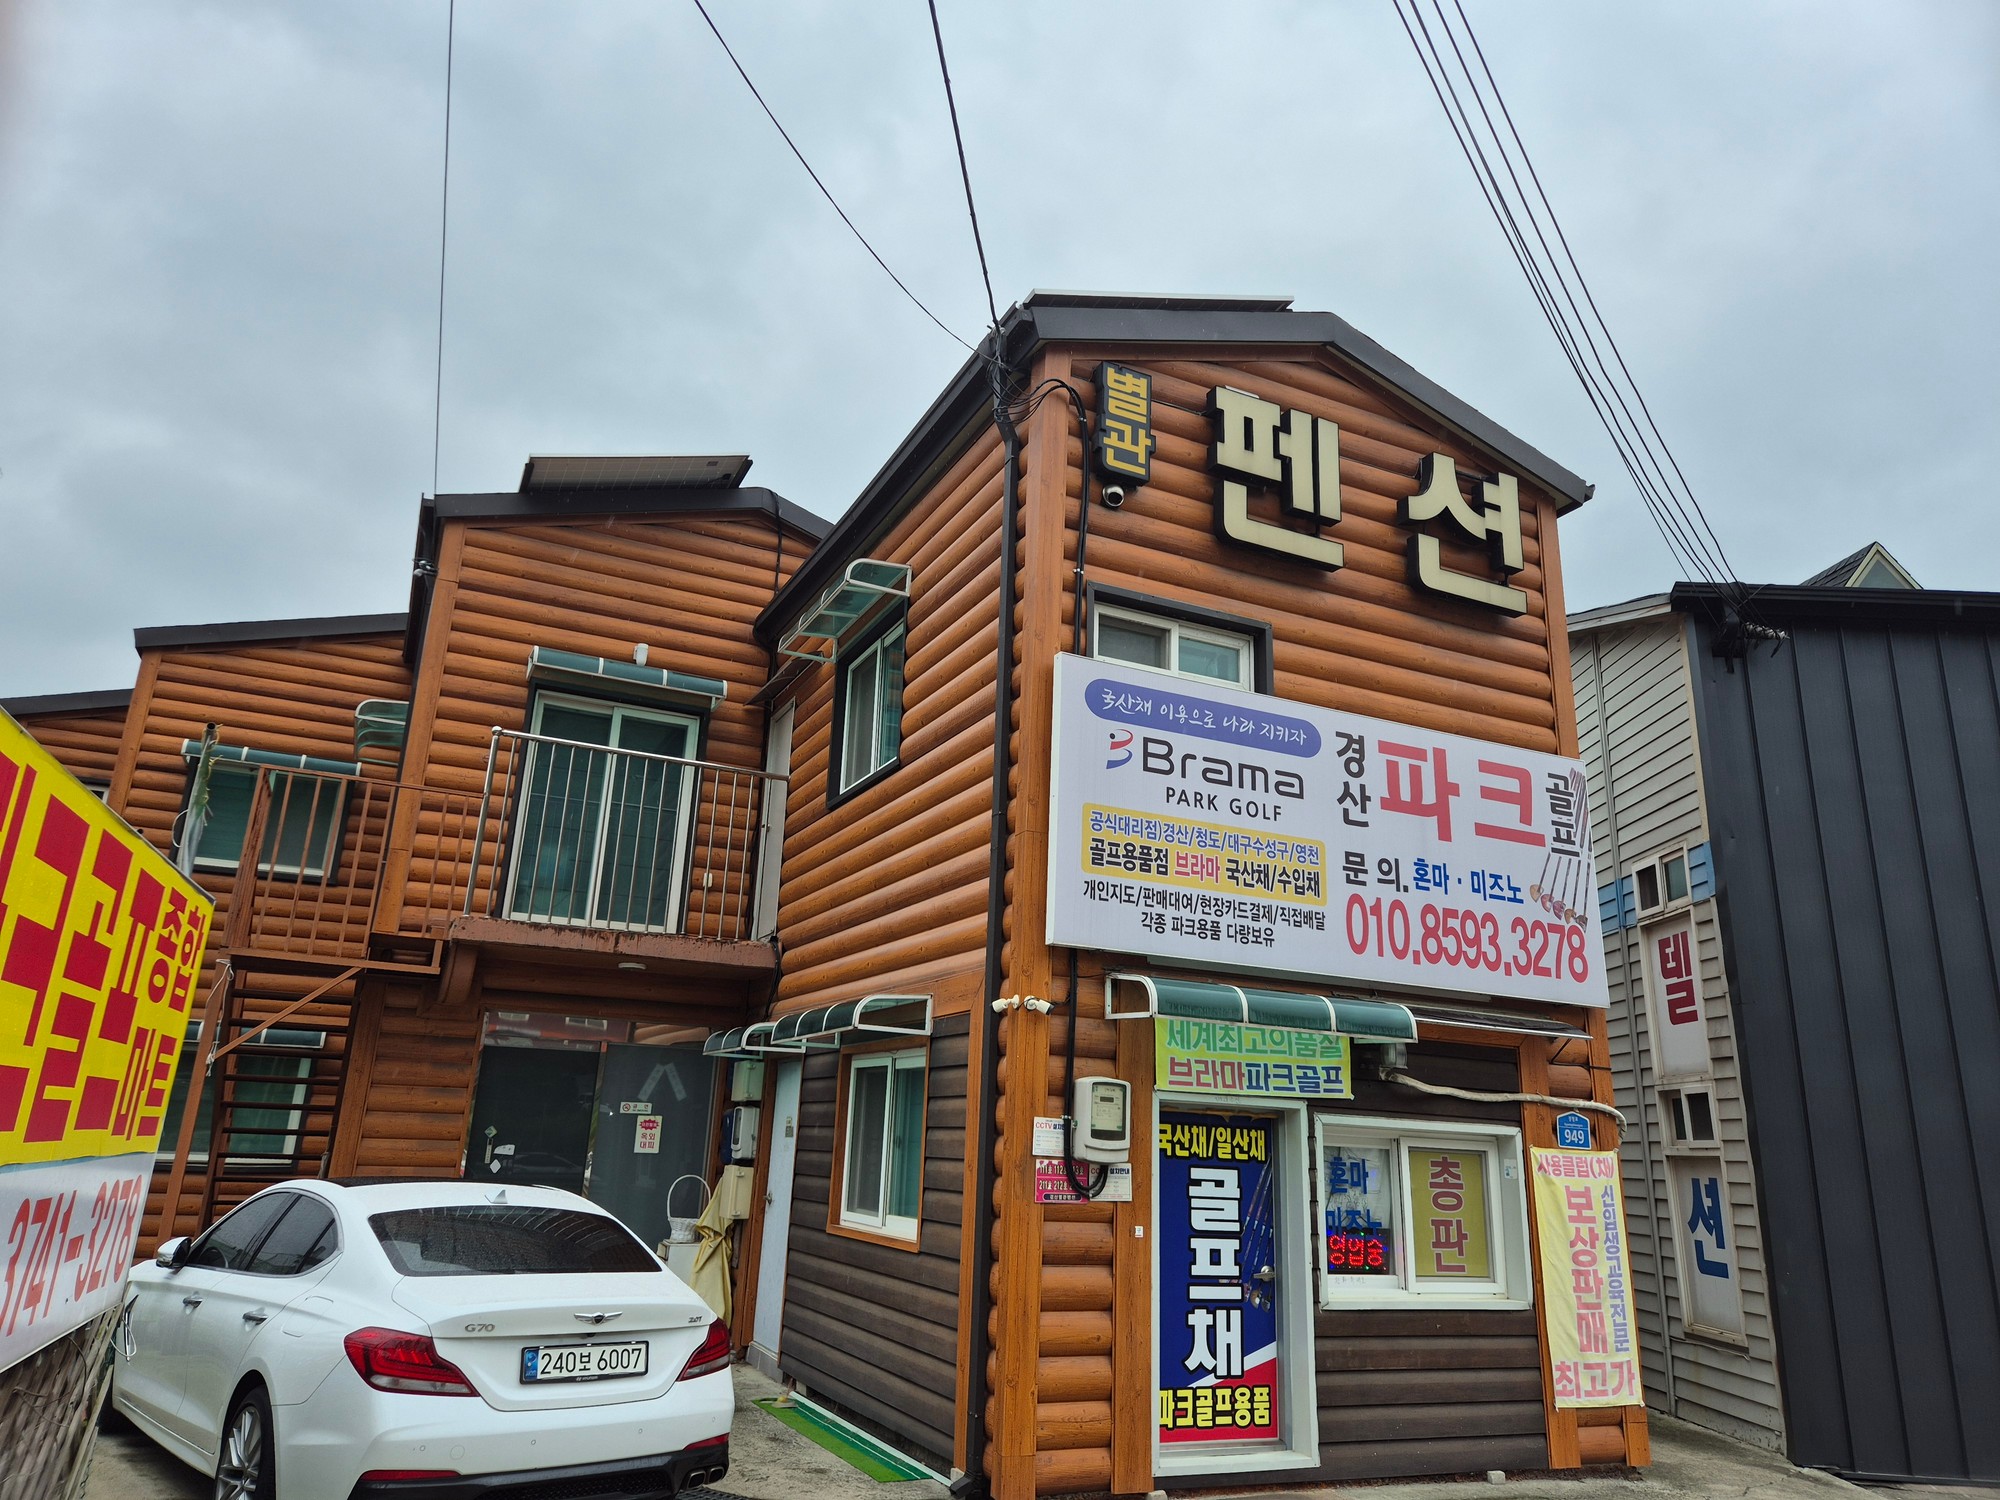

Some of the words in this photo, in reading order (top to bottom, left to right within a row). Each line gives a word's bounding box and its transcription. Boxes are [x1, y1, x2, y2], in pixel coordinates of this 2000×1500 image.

[1104, 367, 1151, 475] 별관
[1210, 386, 1527, 617] 펜션
[1101, 687, 1152, 716] 국산채
[1160, 703, 1217, 729] 이용으로
[1223, 716, 1255, 735] 나라
[1261, 723, 1307, 746] 지키자
[1142, 736, 1305, 800] Brama
[1336, 731, 1371, 827] 경산
[1377, 740, 1546, 848] 파크
[1545, 772, 1580, 858] 골프
[1166, 786, 1219, 812] PARK
[1229, 801, 1282, 822] GOLF
[1089, 836, 1169, 877] 골프용품점
[1174, 851, 1221, 885] 브라마
[1225, 858, 1320, 899] 국산채/수입채
[1412, 857, 1450, 895] 혼마
[1469, 869, 1524, 905] 미즈노
[148, 886, 204, 1012] 종합
[1141, 911, 1167, 935] 각종
[1171, 918, 1221, 942] 파크용품
[1226, 923, 1275, 948] 다량보유
[1345, 893, 1589, 983] 010.8593.3278
[1657, 931, 1698, 1025] 텔
[112, 1027, 174, 1141] 마트
[1564, 1129, 1585, 1145] 949
[1329, 1156, 1369, 1194] 혼마
[1429, 1156, 1469, 1273] 총판
[1687, 1177, 1730, 1280] 션
[1184, 1167, 1242, 1377] 골프채
[1329, 1231, 1383, 1267] 영업중
[465, 1323, 496, 1333] G70
[540, 1350, 591, 1375] 240보
[597, 1348, 642, 1371] 6007
[1555, 1359, 1636, 1400] 최고가
